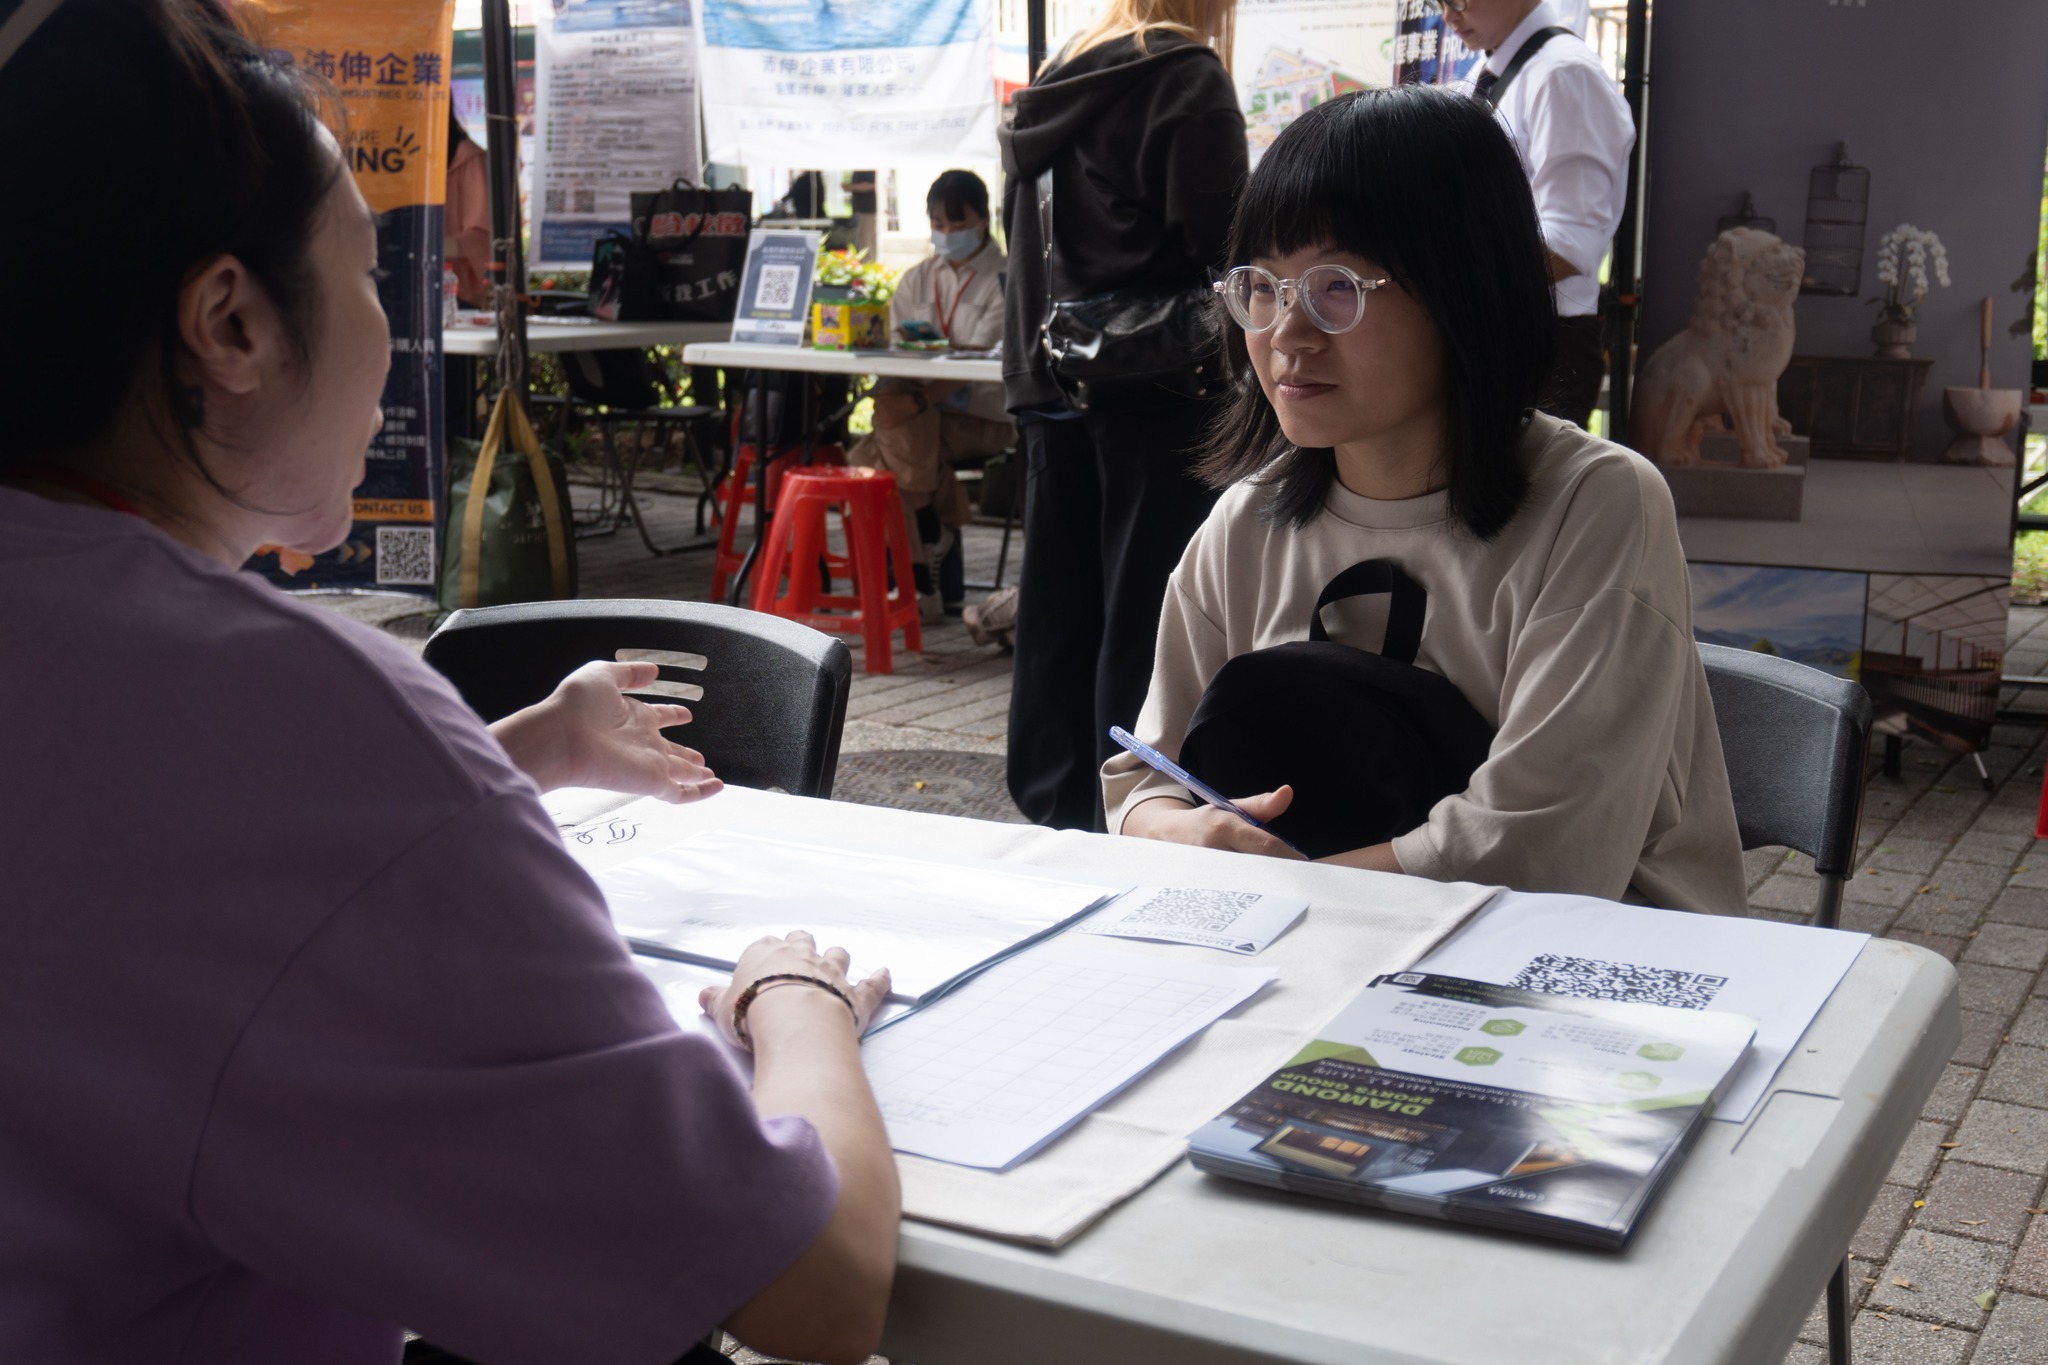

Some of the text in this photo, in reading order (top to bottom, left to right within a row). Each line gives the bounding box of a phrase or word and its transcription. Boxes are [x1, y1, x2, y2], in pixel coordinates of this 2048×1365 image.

[347, 147, 405, 173] ING
[353, 503, 404, 514] ONTACT
[1076, 925, 1151, 937] CORTIN
[1279, 1072, 1350, 1091] GROUP
[1271, 1078, 1427, 1117] DIAMOND
[1355, 1086, 1436, 1105] SPORTS
